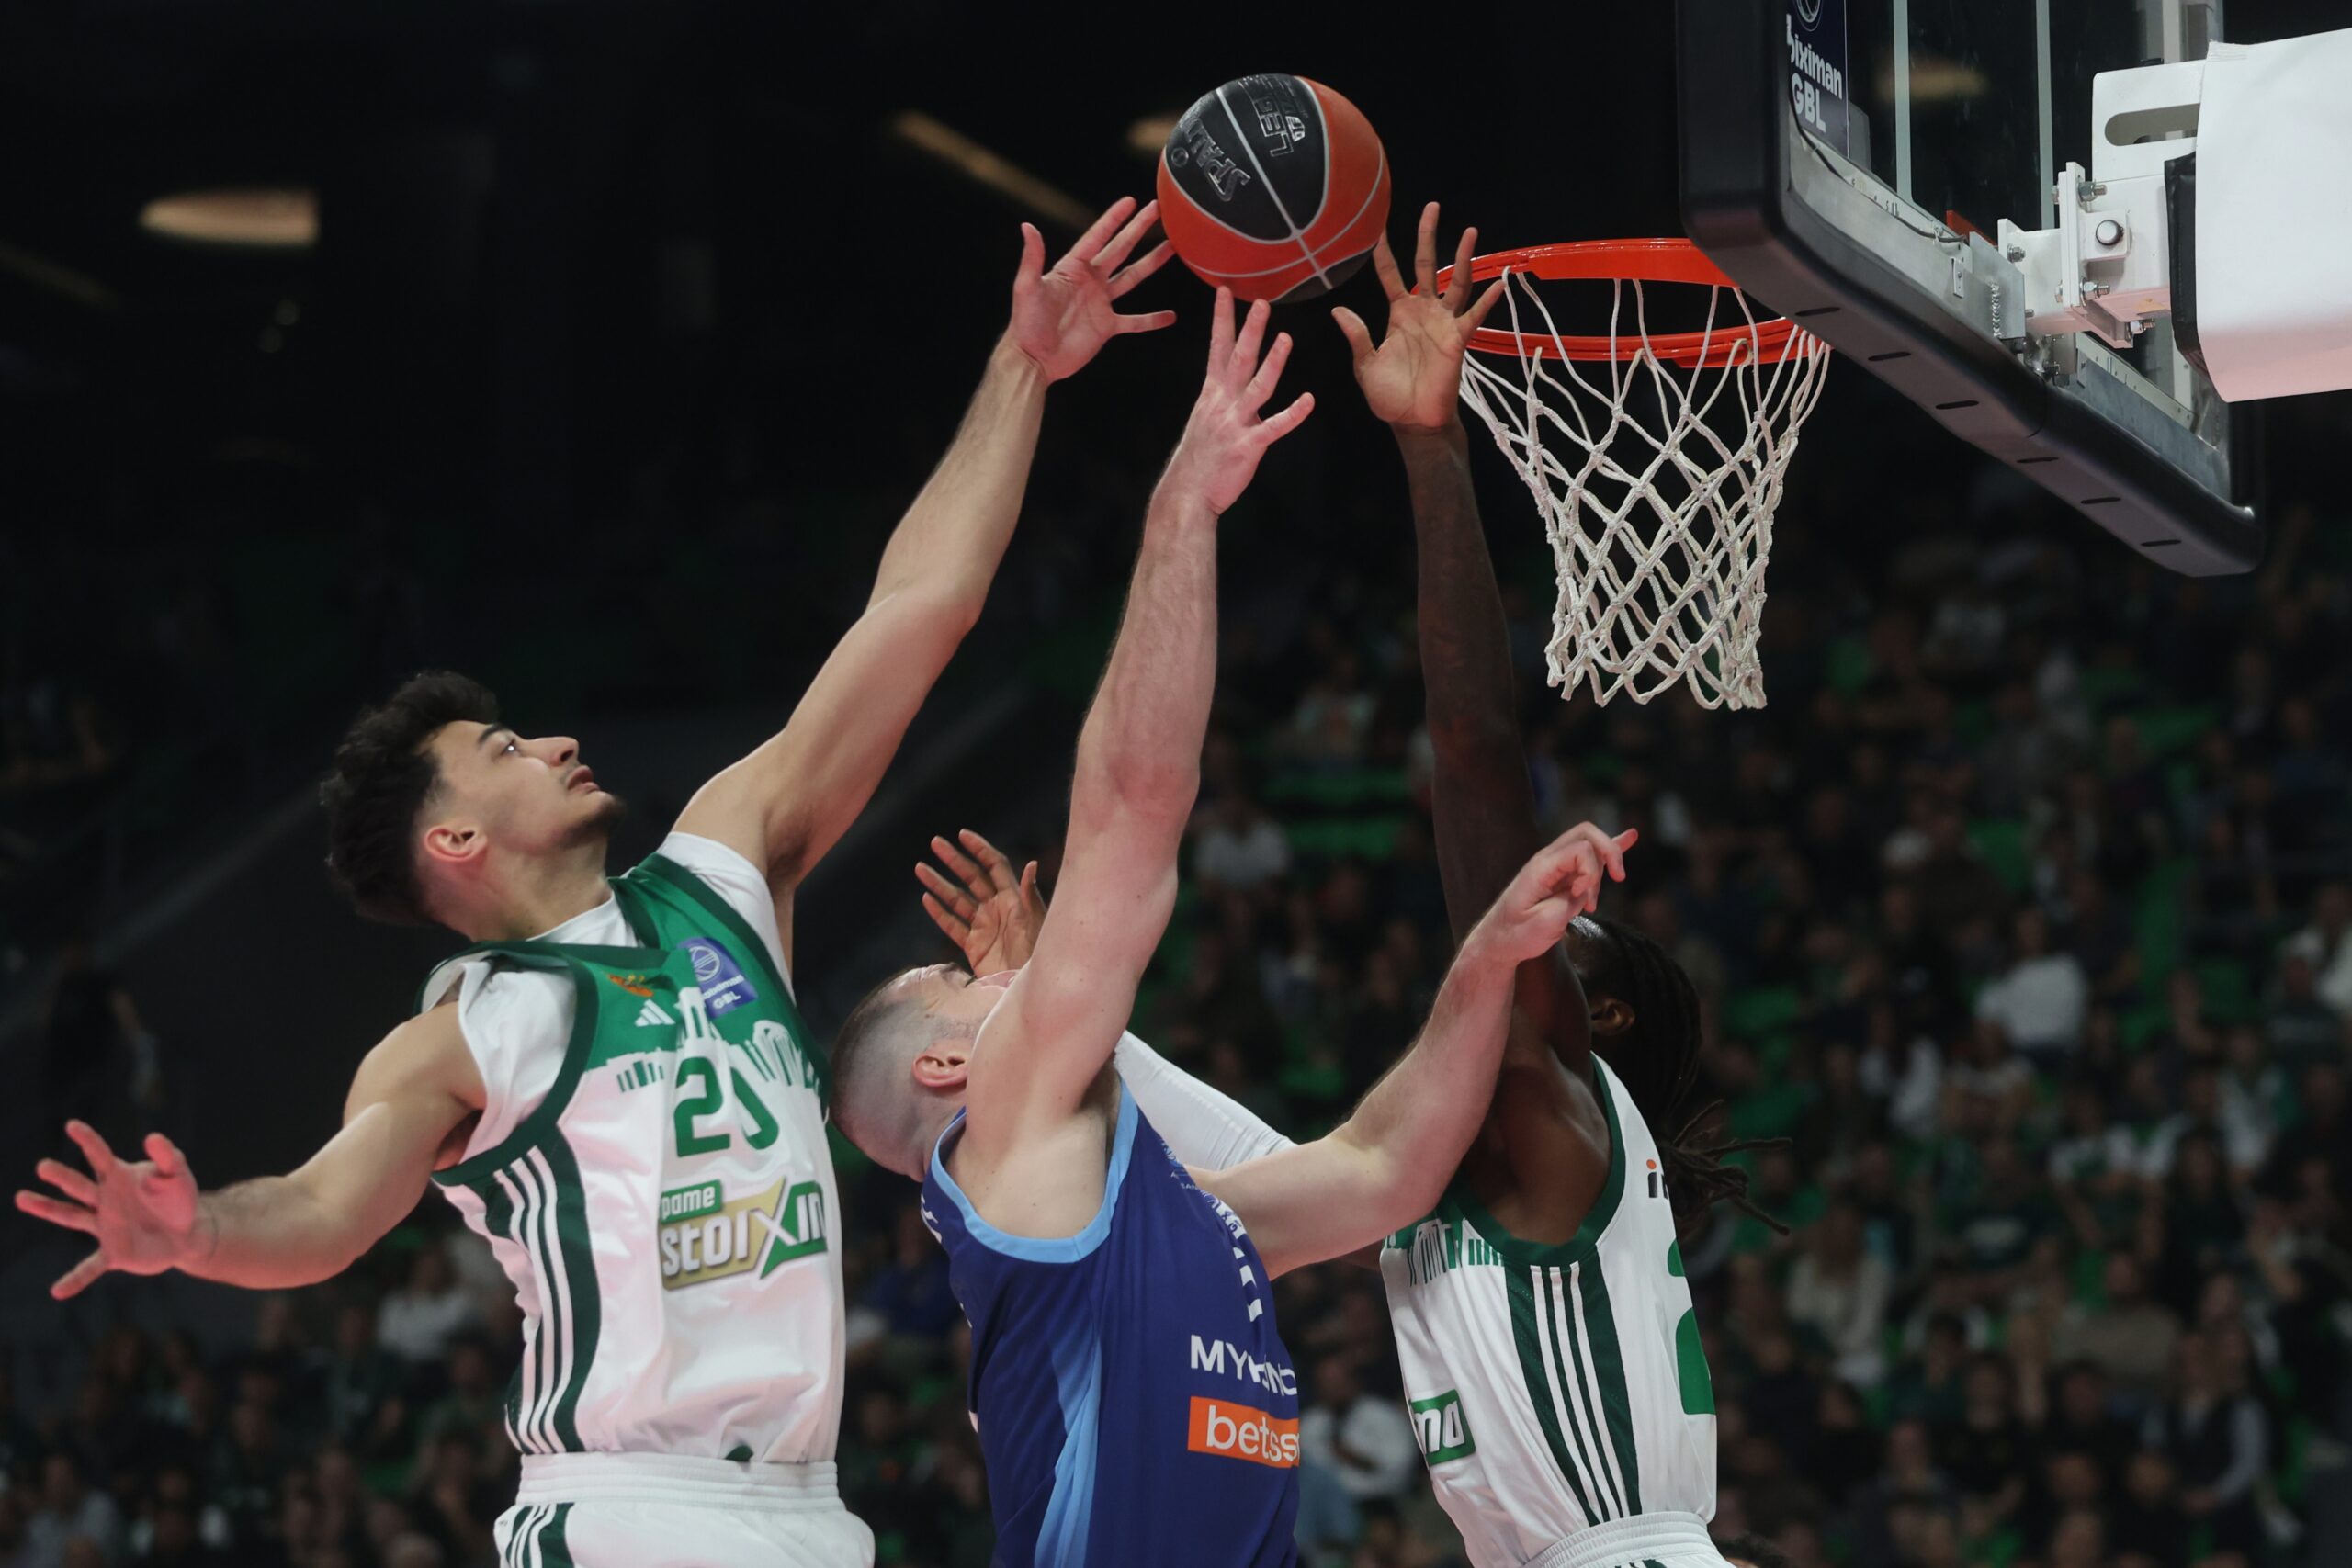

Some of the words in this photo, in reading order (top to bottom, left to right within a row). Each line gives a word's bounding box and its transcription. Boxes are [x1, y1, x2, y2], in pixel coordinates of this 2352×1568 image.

[1792, 73, 1826, 133] GBL
[662, 1186, 716, 1221] pame
[1206, 1404, 1300, 1461] betss
